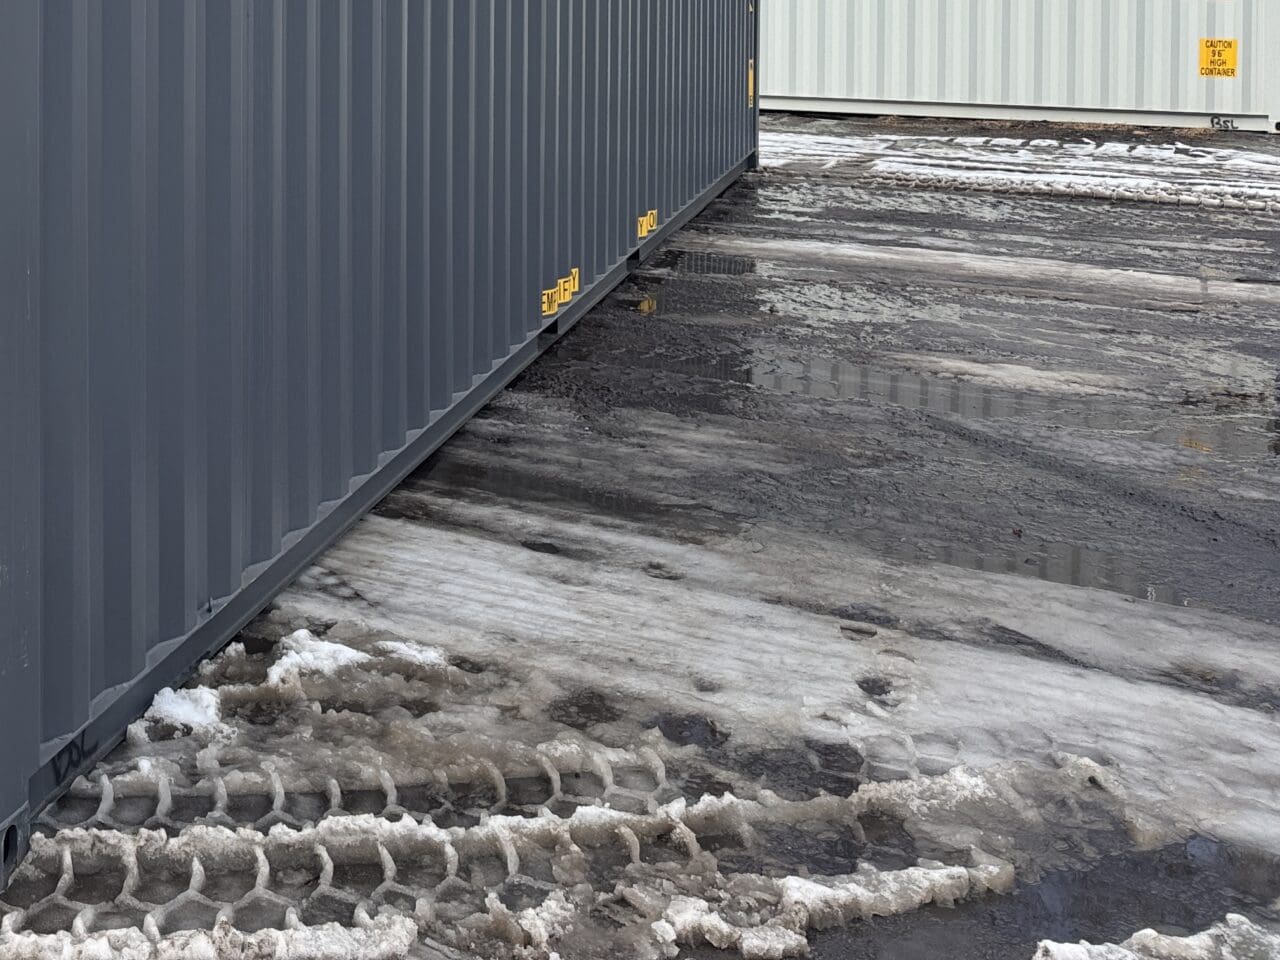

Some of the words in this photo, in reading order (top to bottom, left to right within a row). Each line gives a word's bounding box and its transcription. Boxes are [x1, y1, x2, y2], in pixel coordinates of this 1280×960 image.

[1205, 40, 1232, 49] CAUTION
[1209, 59, 1227, 67] HIGH
[1200, 67, 1236, 77] CONTAINER
